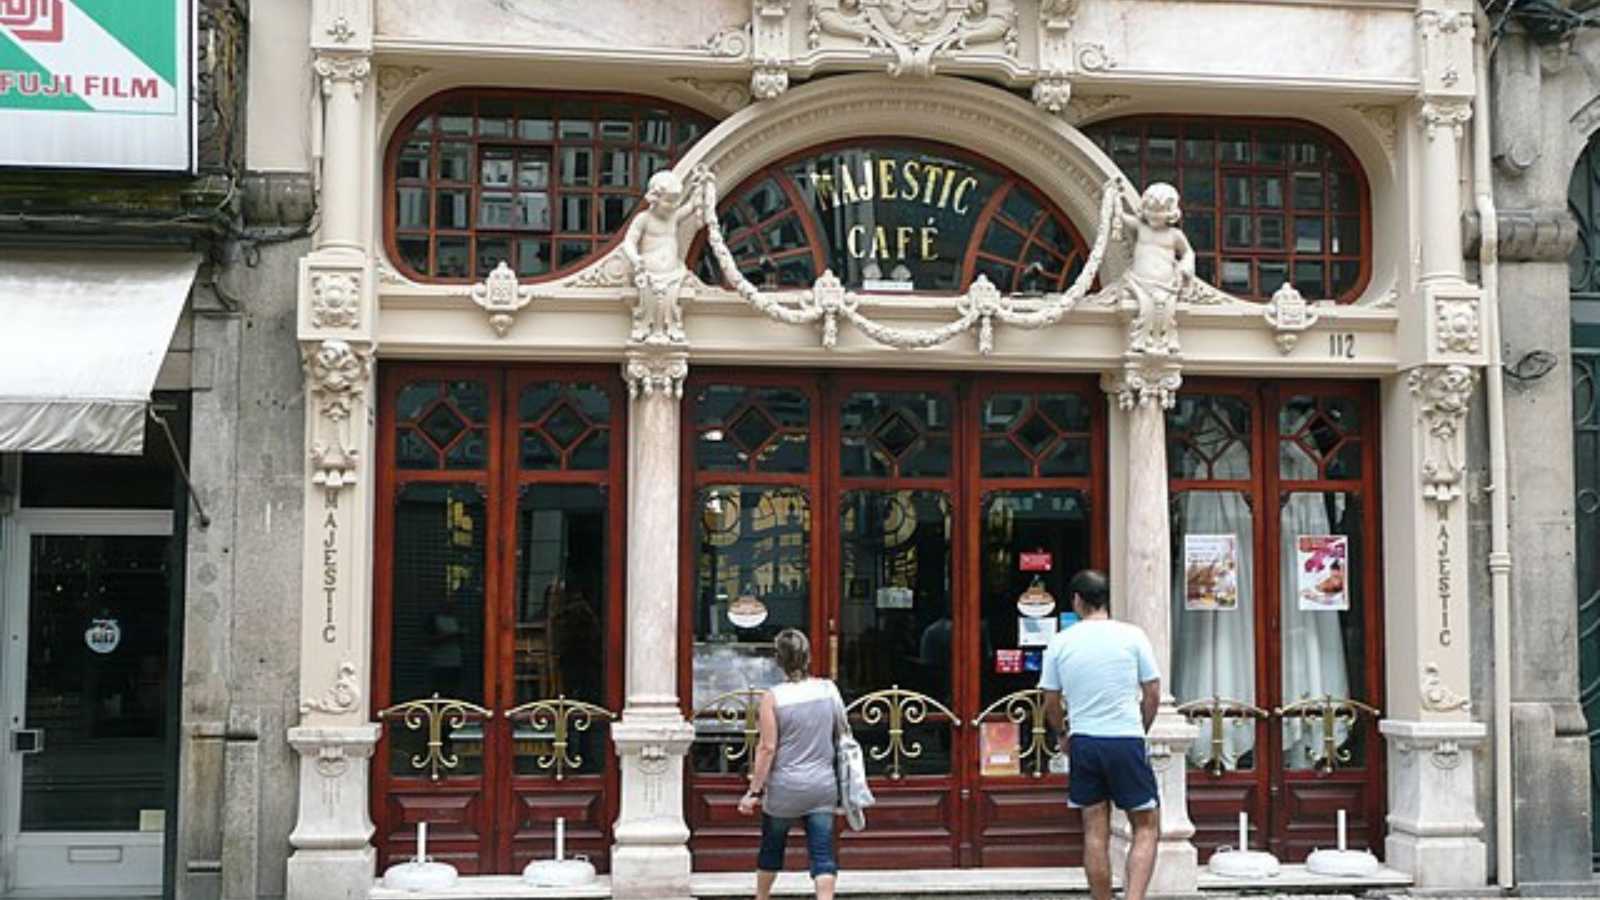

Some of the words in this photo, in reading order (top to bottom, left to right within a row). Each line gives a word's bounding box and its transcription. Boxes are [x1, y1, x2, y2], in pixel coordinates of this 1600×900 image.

[0, 73, 73, 94] FUJI
[84, 76, 158, 98] FILM
[810, 158, 977, 216] MAJESTIC
[847, 217, 939, 261] CAFÉ
[1329, 333, 1355, 359] 112
[322, 489, 338, 643] MAJESTIC
